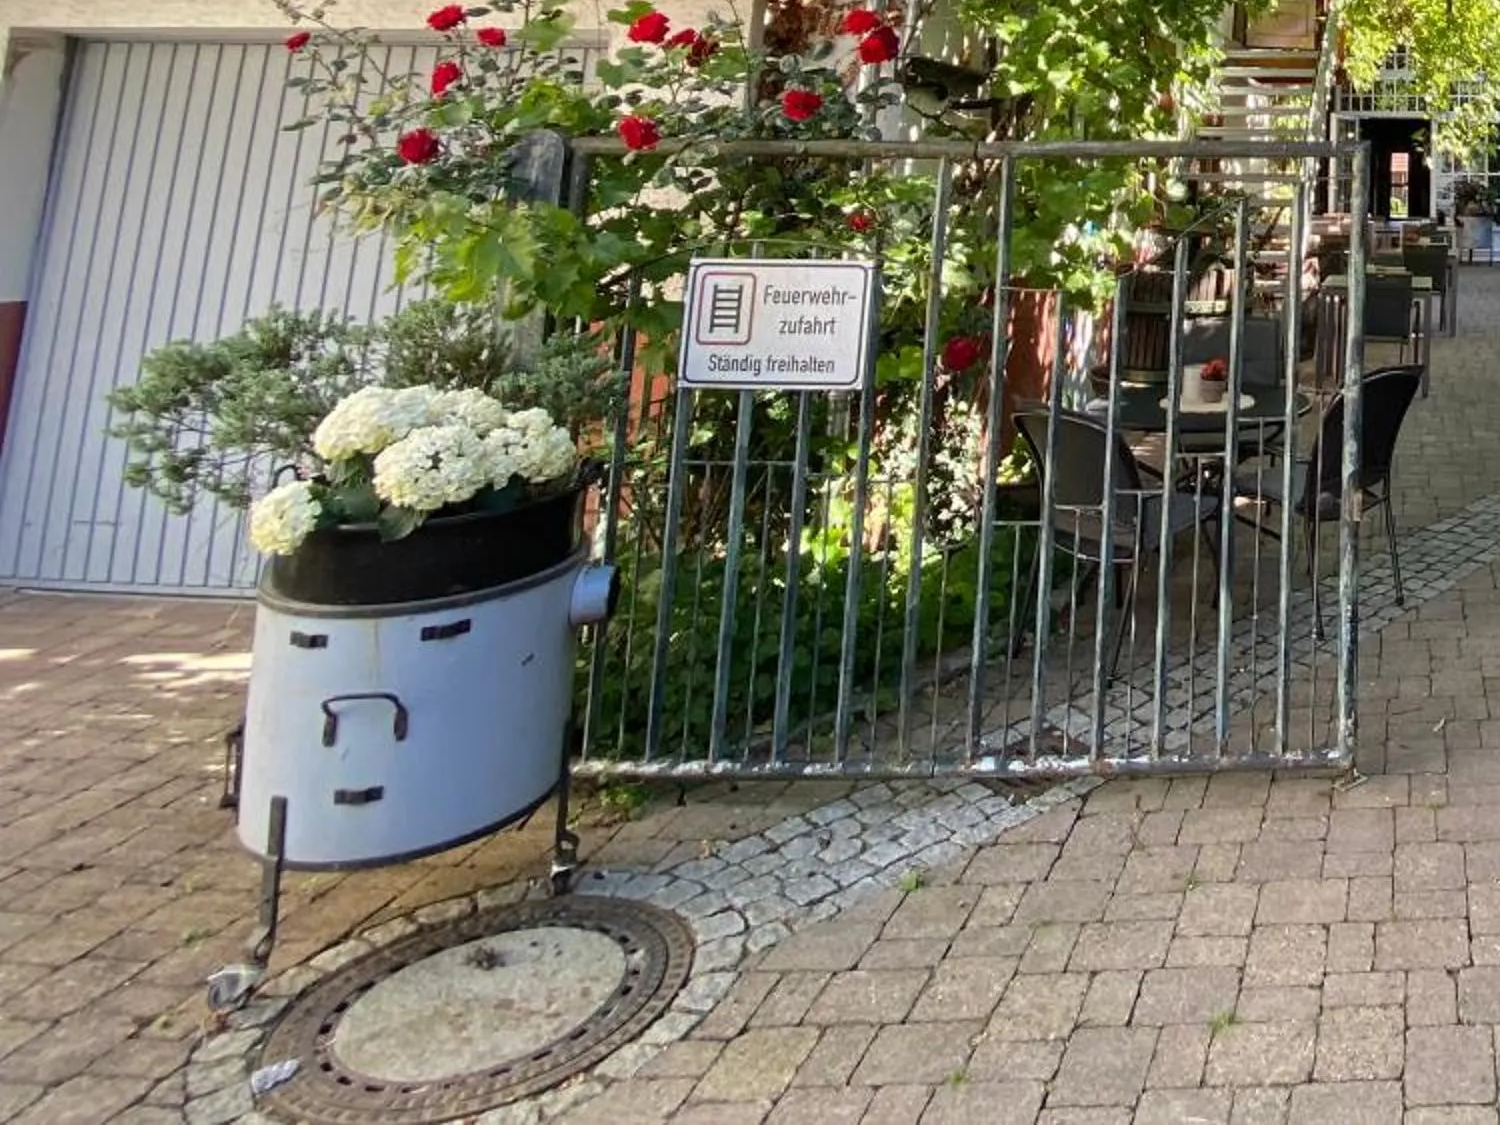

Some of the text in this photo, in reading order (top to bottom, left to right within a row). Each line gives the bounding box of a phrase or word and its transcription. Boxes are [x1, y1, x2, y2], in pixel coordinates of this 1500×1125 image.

[763, 284, 857, 306] Feuerwehr-
[779, 314, 837, 336] zufahrt
[707, 354, 835, 376] Ständig freihalten
